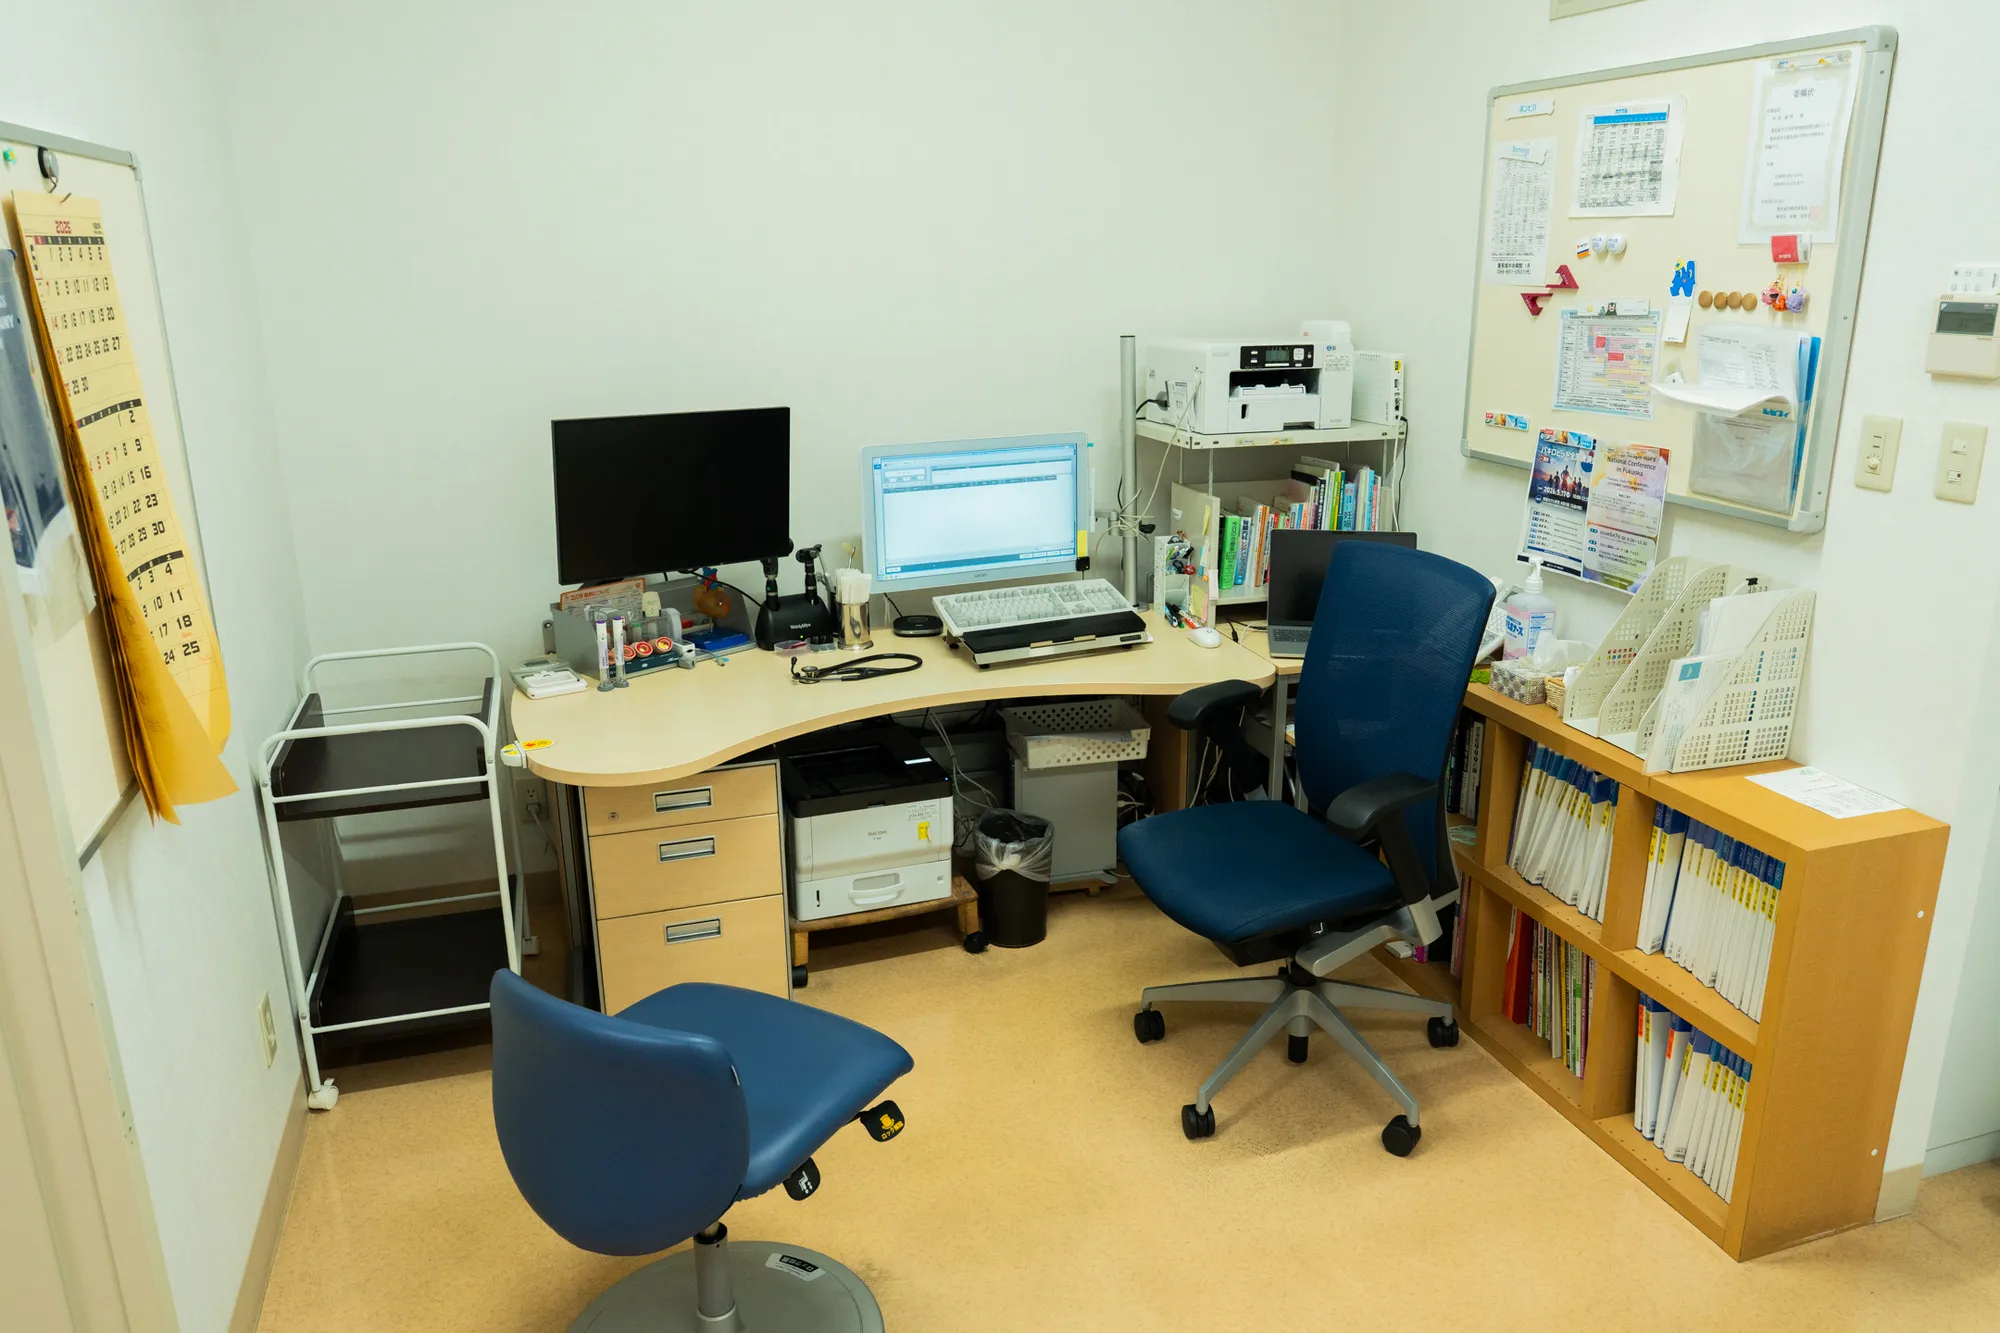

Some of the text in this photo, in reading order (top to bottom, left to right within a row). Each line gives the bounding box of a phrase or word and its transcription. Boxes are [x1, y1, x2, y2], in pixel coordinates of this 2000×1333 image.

[112, 336, 120, 350] 27
[129, 410, 135, 423] 2
[135, 438, 142, 452] 9
[1607, 456, 1656, 470] National Conference
[1623, 467, 1643, 476] Fukuoka
[140, 466, 152, 480] 16
[133, 499, 141, 514] 22
[145, 493, 158, 508] 23
[138, 526, 148, 542] 29
[152, 520, 165, 536] 30
[149, 570, 154, 583] 3
[165, 563, 172, 575] 4
[153, 596, 163, 611] 10
[170, 589, 183, 603] 11
[159, 614, 192, 638] 17 18
[164, 640, 200, 665] 24 25
